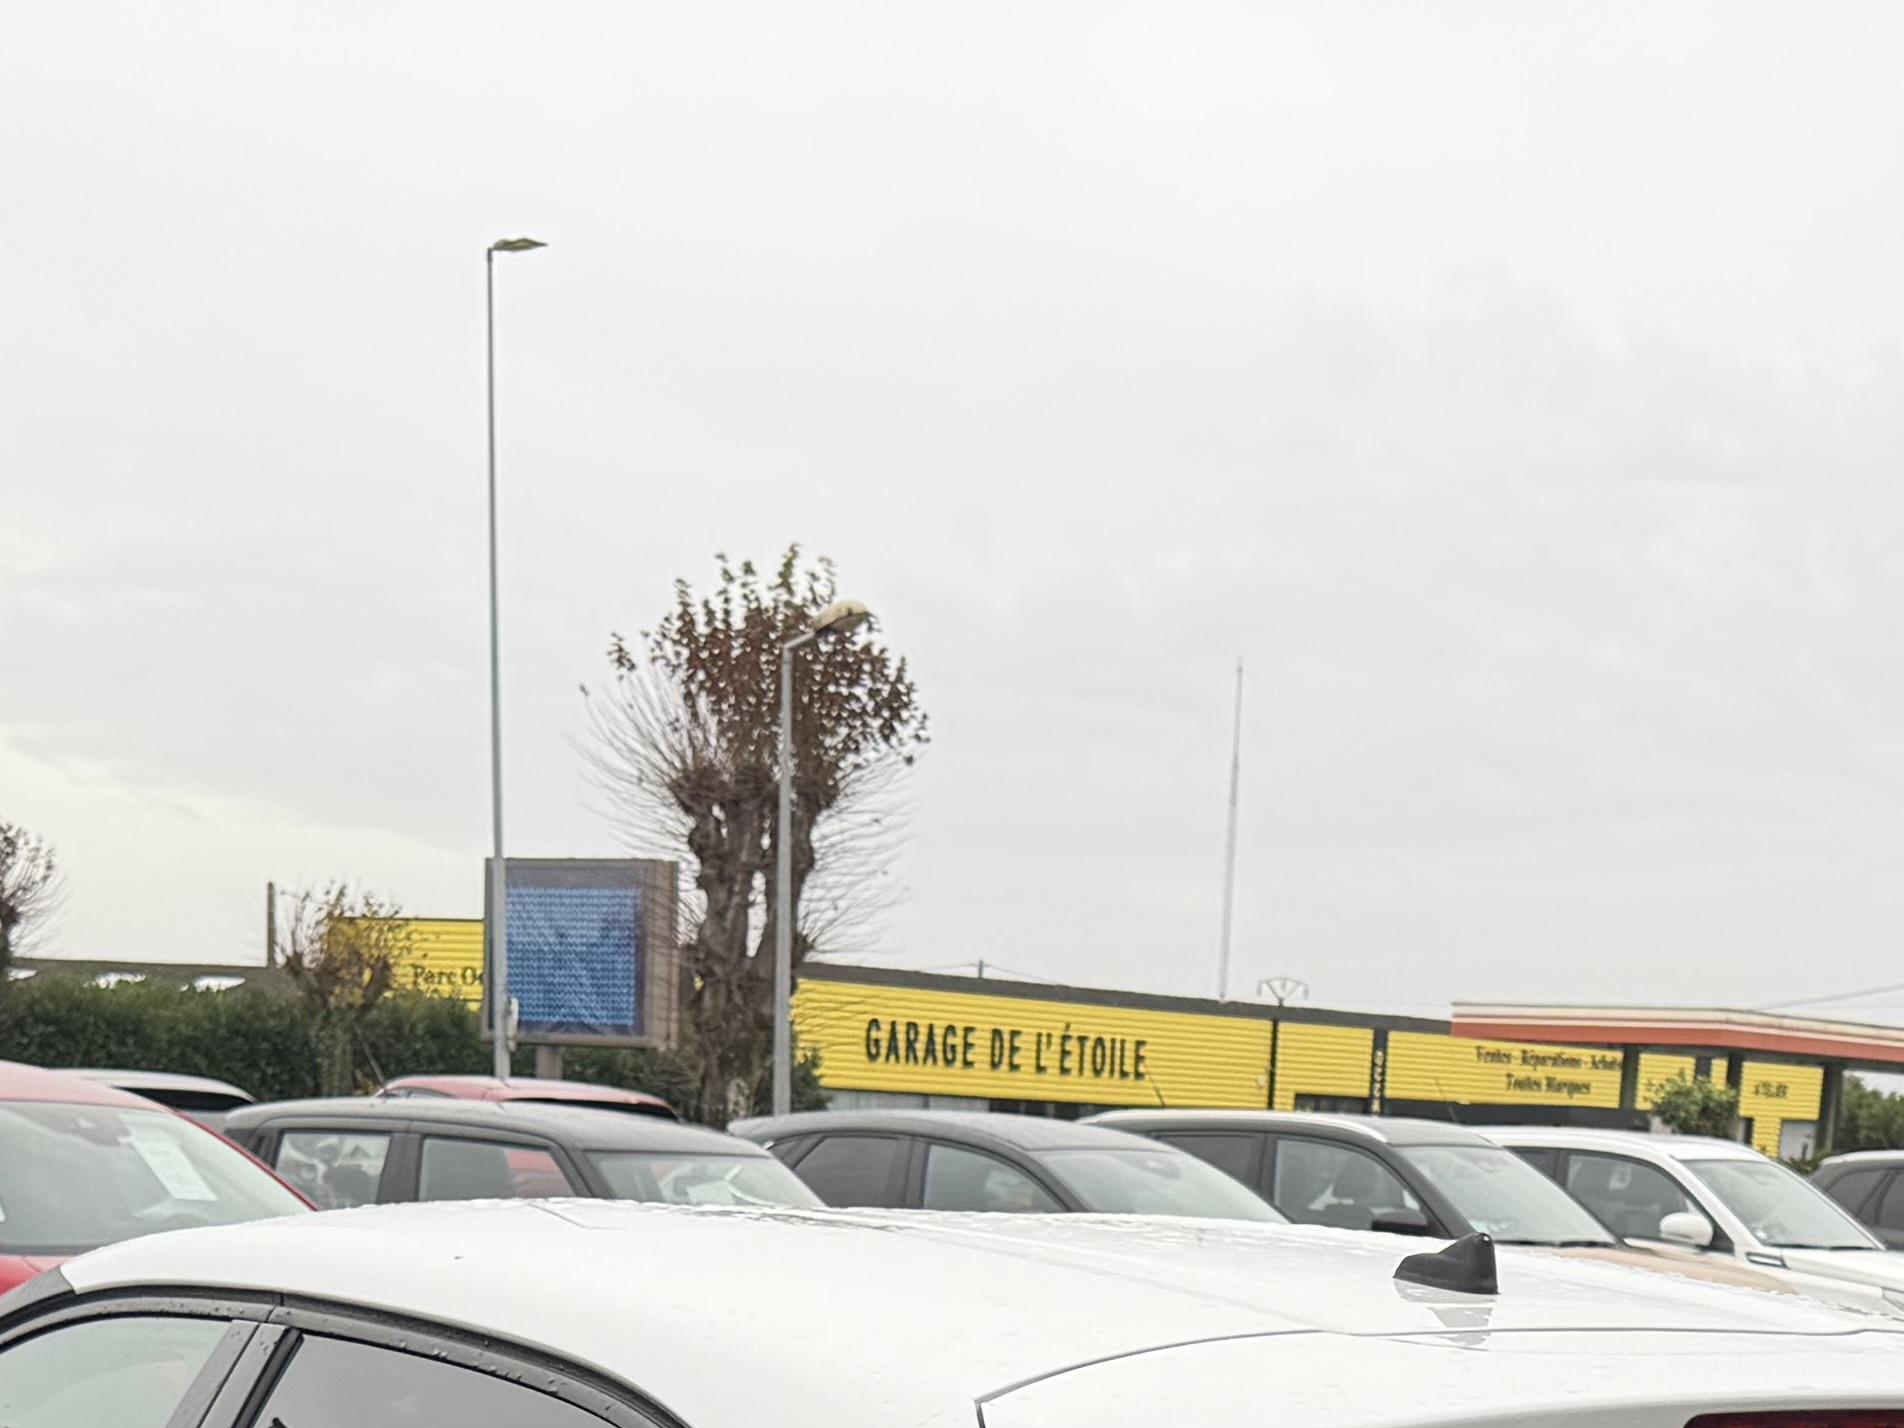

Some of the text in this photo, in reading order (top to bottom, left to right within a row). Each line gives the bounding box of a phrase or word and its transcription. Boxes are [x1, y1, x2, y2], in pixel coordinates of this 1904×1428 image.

[864, 1017, 1148, 1081] GARAGE DE L'ÉTOILE
